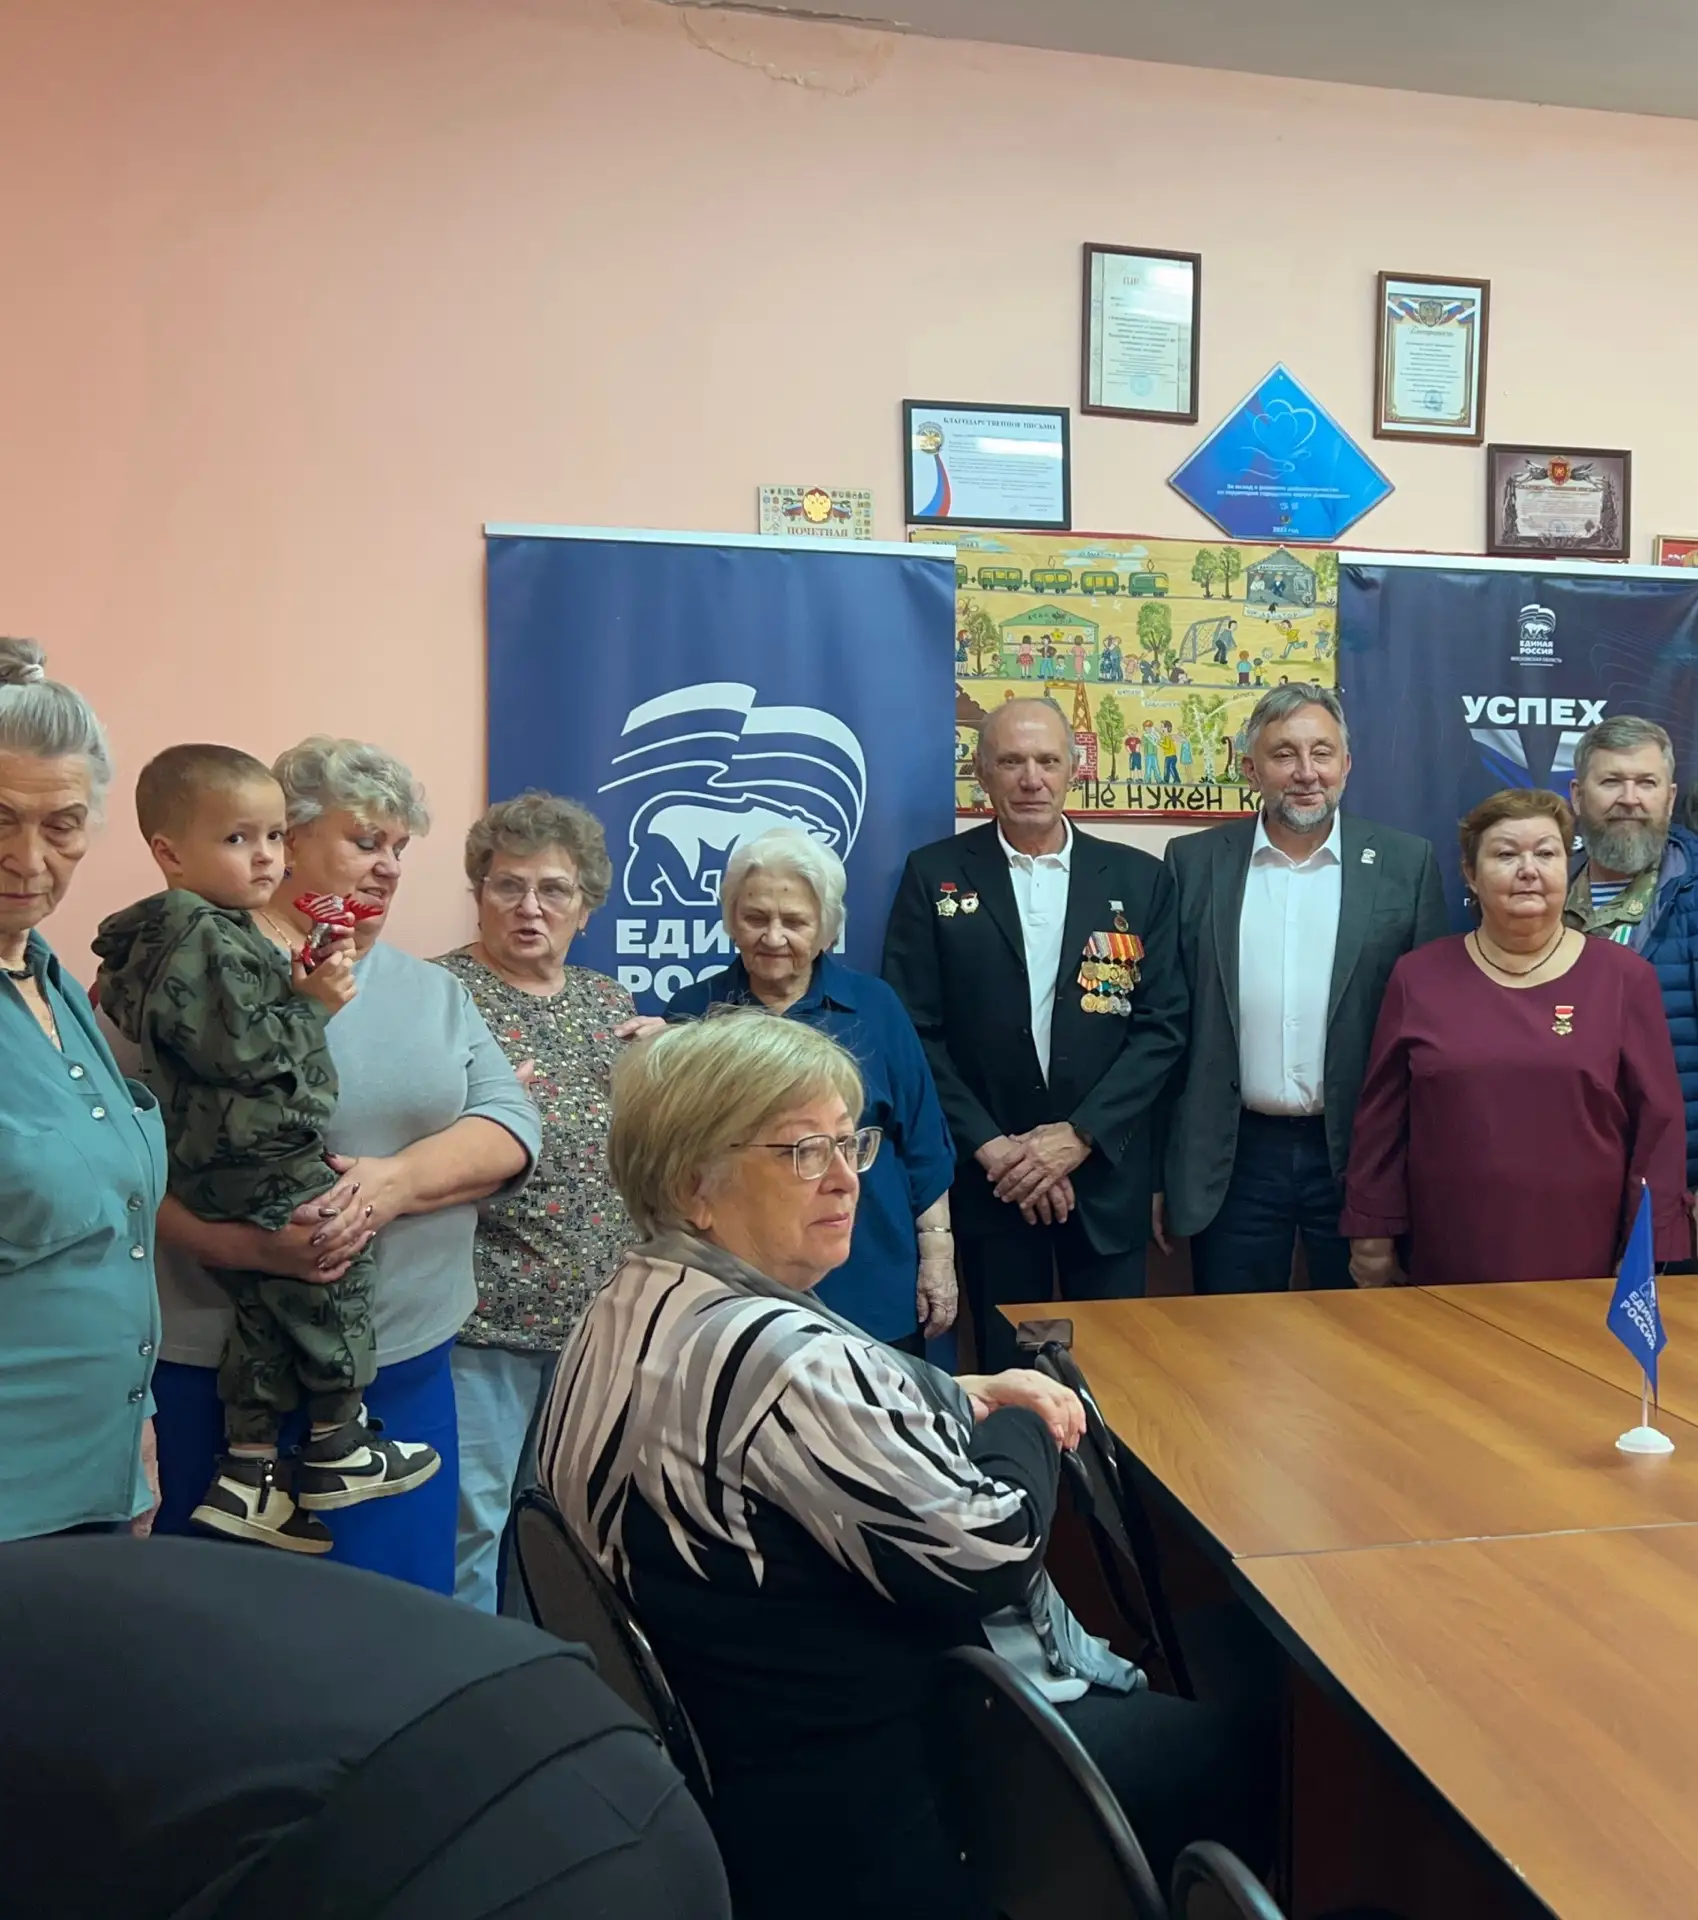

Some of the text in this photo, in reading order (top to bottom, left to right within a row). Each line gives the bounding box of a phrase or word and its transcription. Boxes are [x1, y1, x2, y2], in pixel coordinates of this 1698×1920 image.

[943, 417, 1056, 430] БЛАГОДАРСТВЕННОЕ ПИСЬМО
[787, 527, 848, 537] ПОЧЕТНАЯ
[1519, 640, 1554, 648] ЕДИНАЯ
[1519, 647, 1554, 655] РОССИЯ
[1462, 696, 1608, 726] УСПЕХ
[1085, 780, 1116, 809] Не
[1127, 783, 1223, 811] нужен
